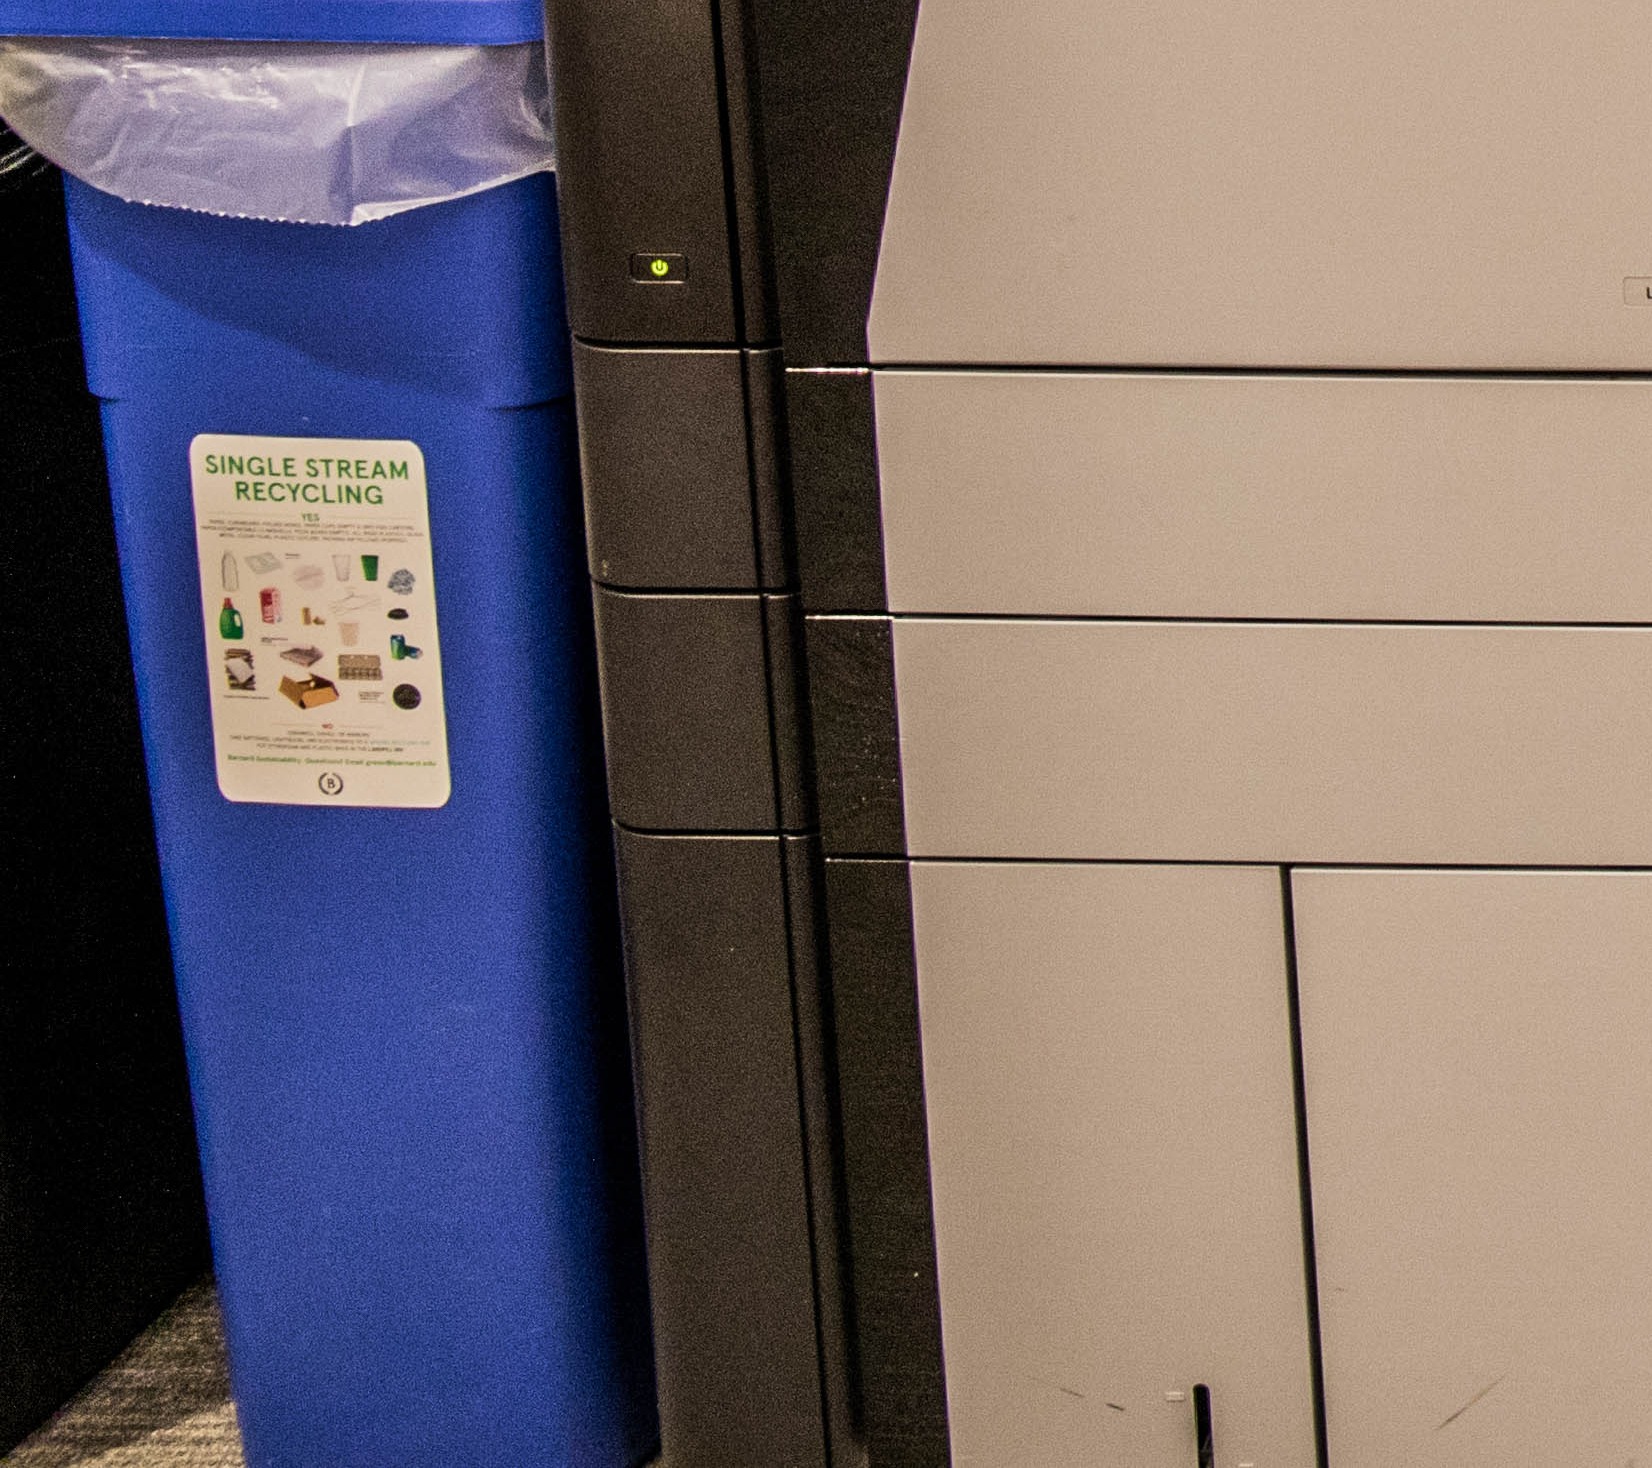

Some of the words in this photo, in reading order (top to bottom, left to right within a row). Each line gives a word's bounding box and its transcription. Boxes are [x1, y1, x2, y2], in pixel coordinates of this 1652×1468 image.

[205, 454, 296, 478] SINGLE
[306, 458, 409, 480] STREAM
[234, 481, 384, 505] RECYCLING
[301, 512, 320, 522] YES
